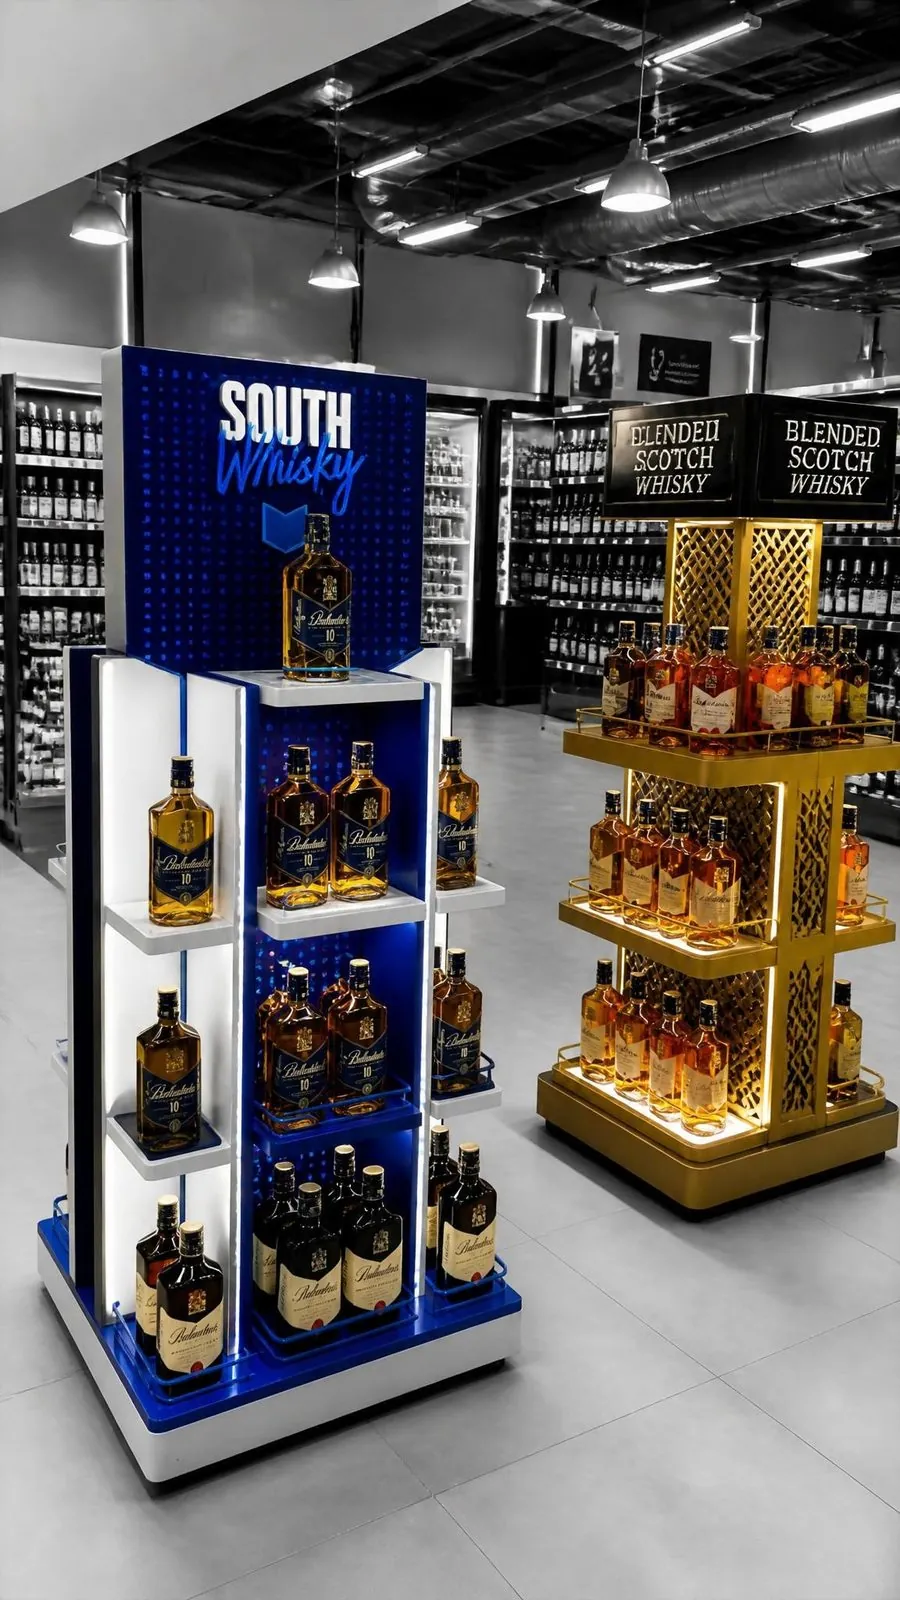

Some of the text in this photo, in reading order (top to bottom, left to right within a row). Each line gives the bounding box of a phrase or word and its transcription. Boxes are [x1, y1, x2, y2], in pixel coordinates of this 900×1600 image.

[220, 380, 352, 449] SOUTH
[785, 420, 880, 448] BLENDED
[634, 446, 714, 471] SCOTCH
[787, 445, 875, 473] SCOTCH
[217, 424, 366, 516] Whisky
[635, 474, 711, 496] WHISKY
[790, 473, 870, 496] WHISKY
[326, 629, 335, 642] 10
[458, 840, 467, 852] 10
[366, 847, 375, 860] 10
[304, 854, 313, 867] 10
[181, 873, 192, 886] 10
[363, 1066, 372, 1078] 10
[300, 1079, 309, 1092] 10
[170, 1101, 179, 1113] 10
